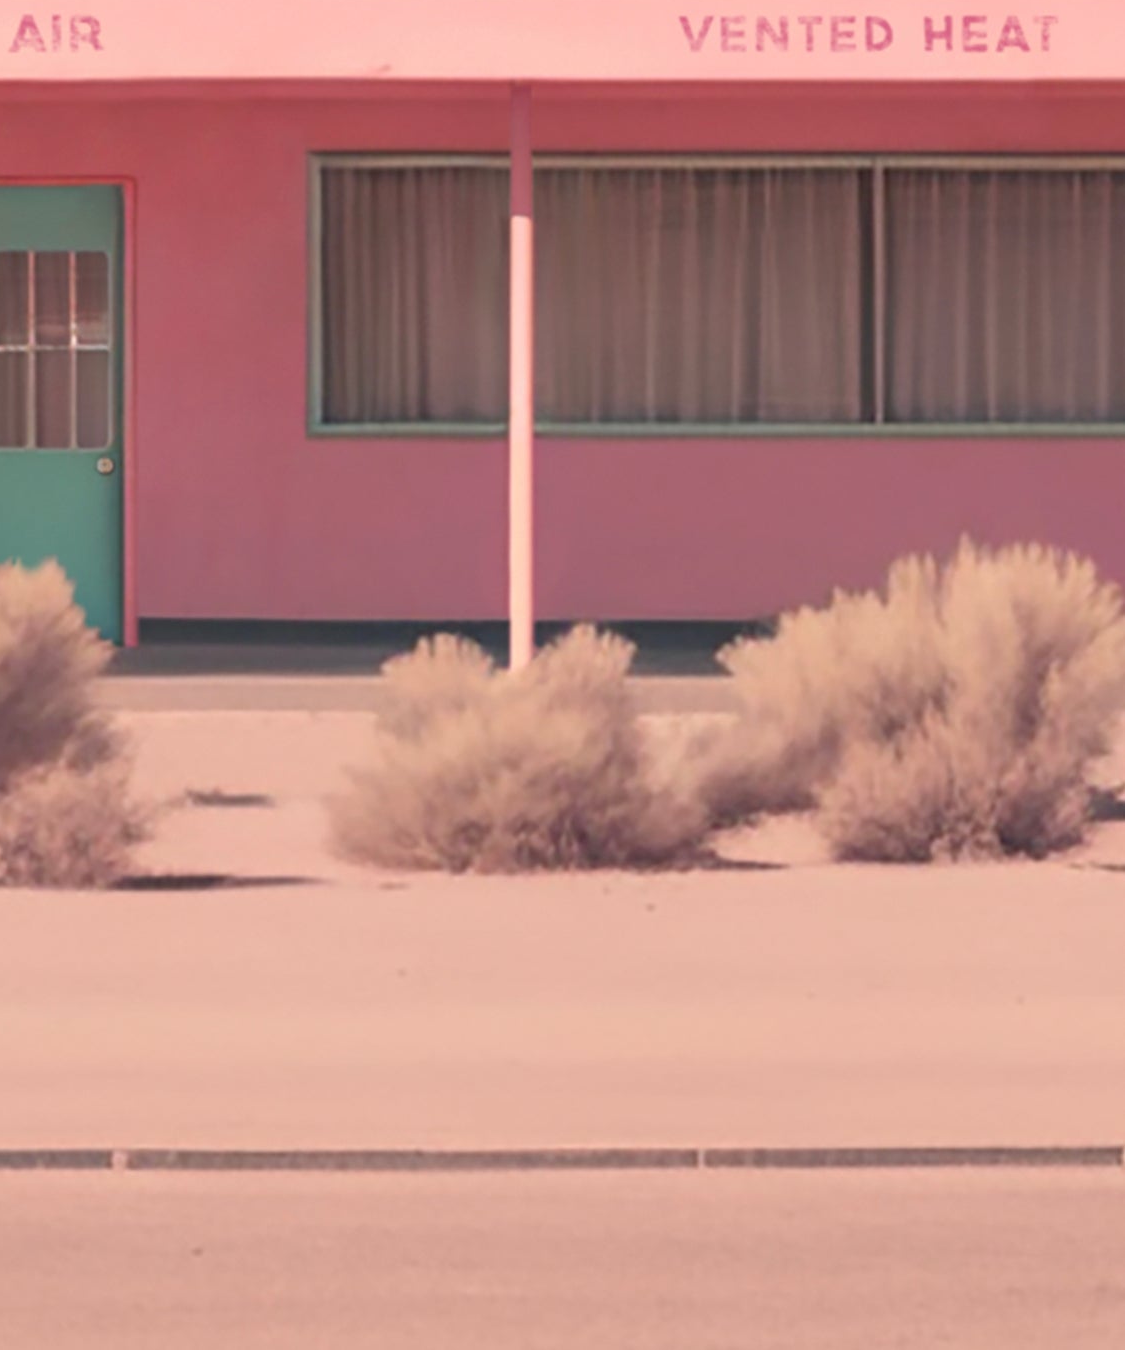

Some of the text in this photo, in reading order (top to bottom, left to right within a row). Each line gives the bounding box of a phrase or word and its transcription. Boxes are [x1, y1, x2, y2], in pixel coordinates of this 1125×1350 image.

[9, 14, 104, 52] AIR
[678, 15, 1059, 52] VENTED HEAT
